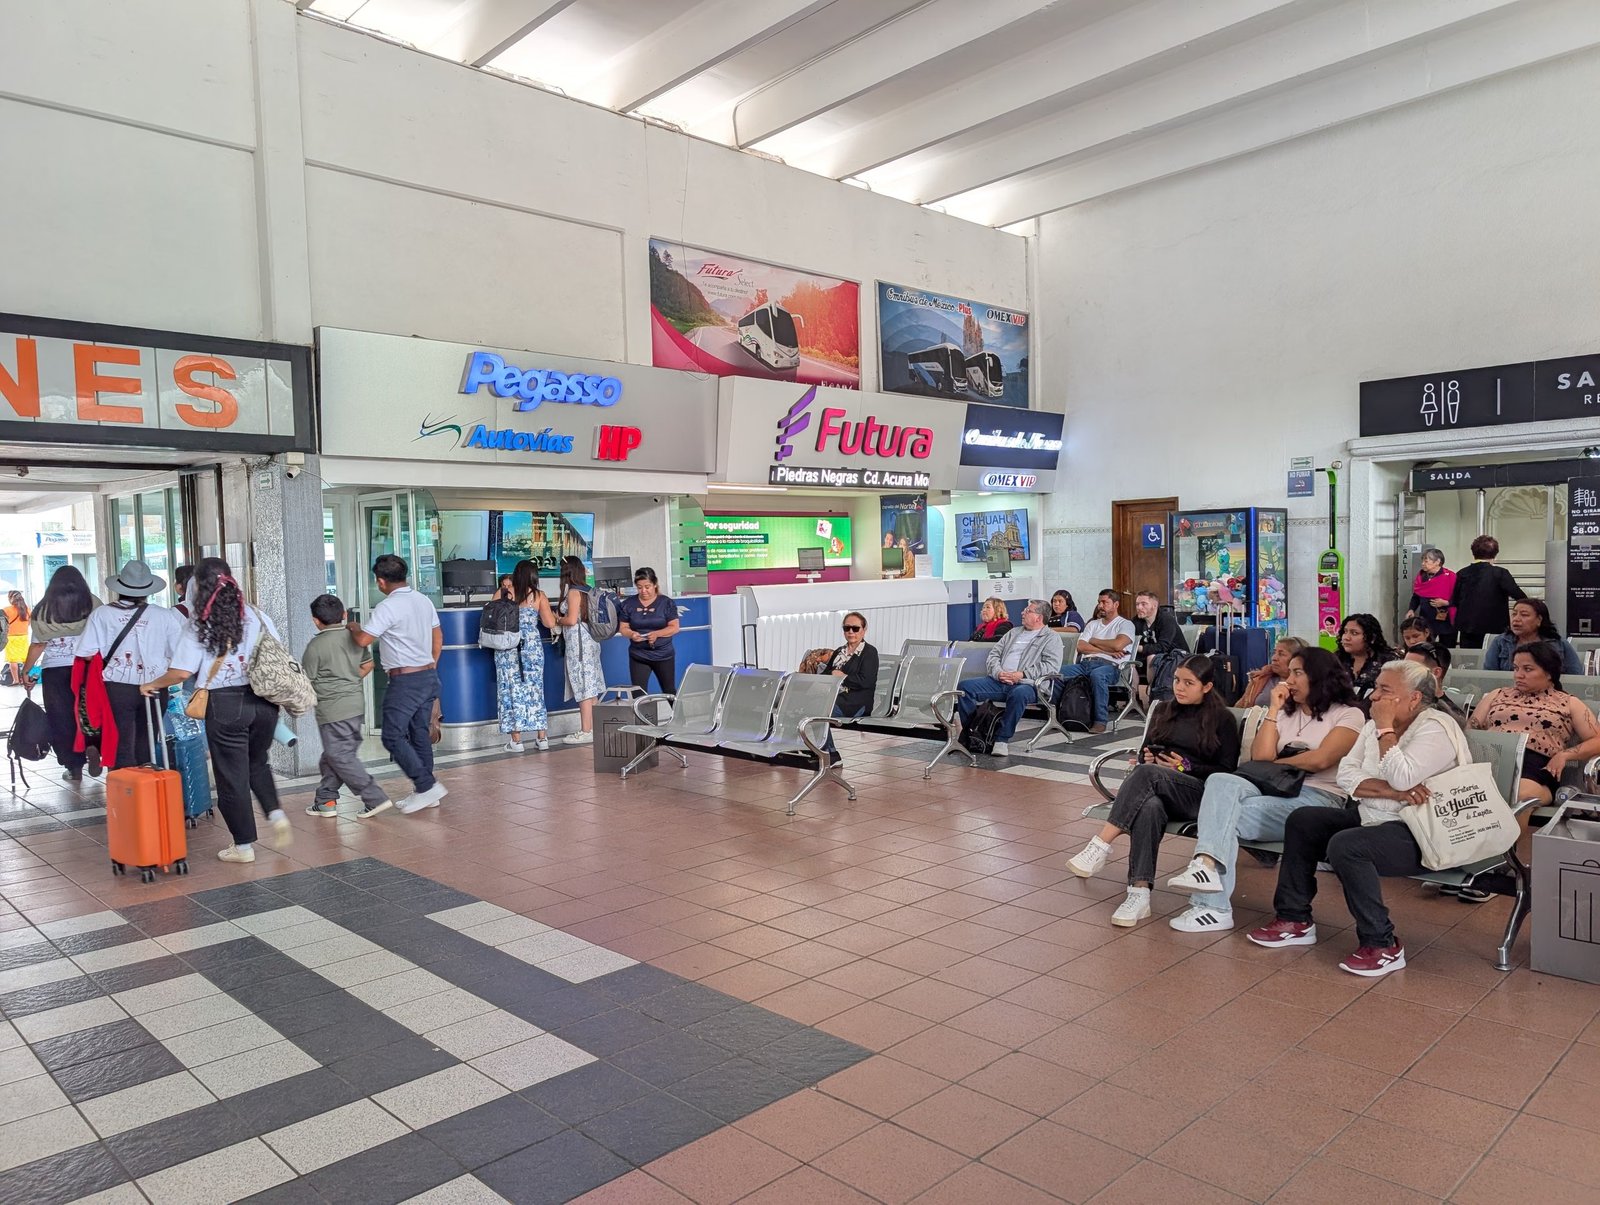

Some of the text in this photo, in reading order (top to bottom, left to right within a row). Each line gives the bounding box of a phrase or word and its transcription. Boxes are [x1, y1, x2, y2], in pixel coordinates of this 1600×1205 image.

[697, 263, 740, 277] Futura
[919, 295, 929, 306] de
[460, 352, 622, 411] Pegasso
[1557, 371, 1596, 389] SA
[815, 407, 933, 459] Futura
[465, 424, 642, 461] Autovías HP
[777, 467, 818, 483] Piedras
[821, 469, 858, 486] Negras
[864, 471, 880, 485] Cd.
[883, 473, 911, 485] Acuna
[988, 475, 1036, 487] OMEX VIP
[1430, 472, 1471, 480] SALIDA
[719, 520, 760, 532] seguridad
[962, 514, 1020, 527] CHIHUAHUA
[1572, 526, 1599, 535] $8.00
[1434, 791, 1488, 818] La Huerta
